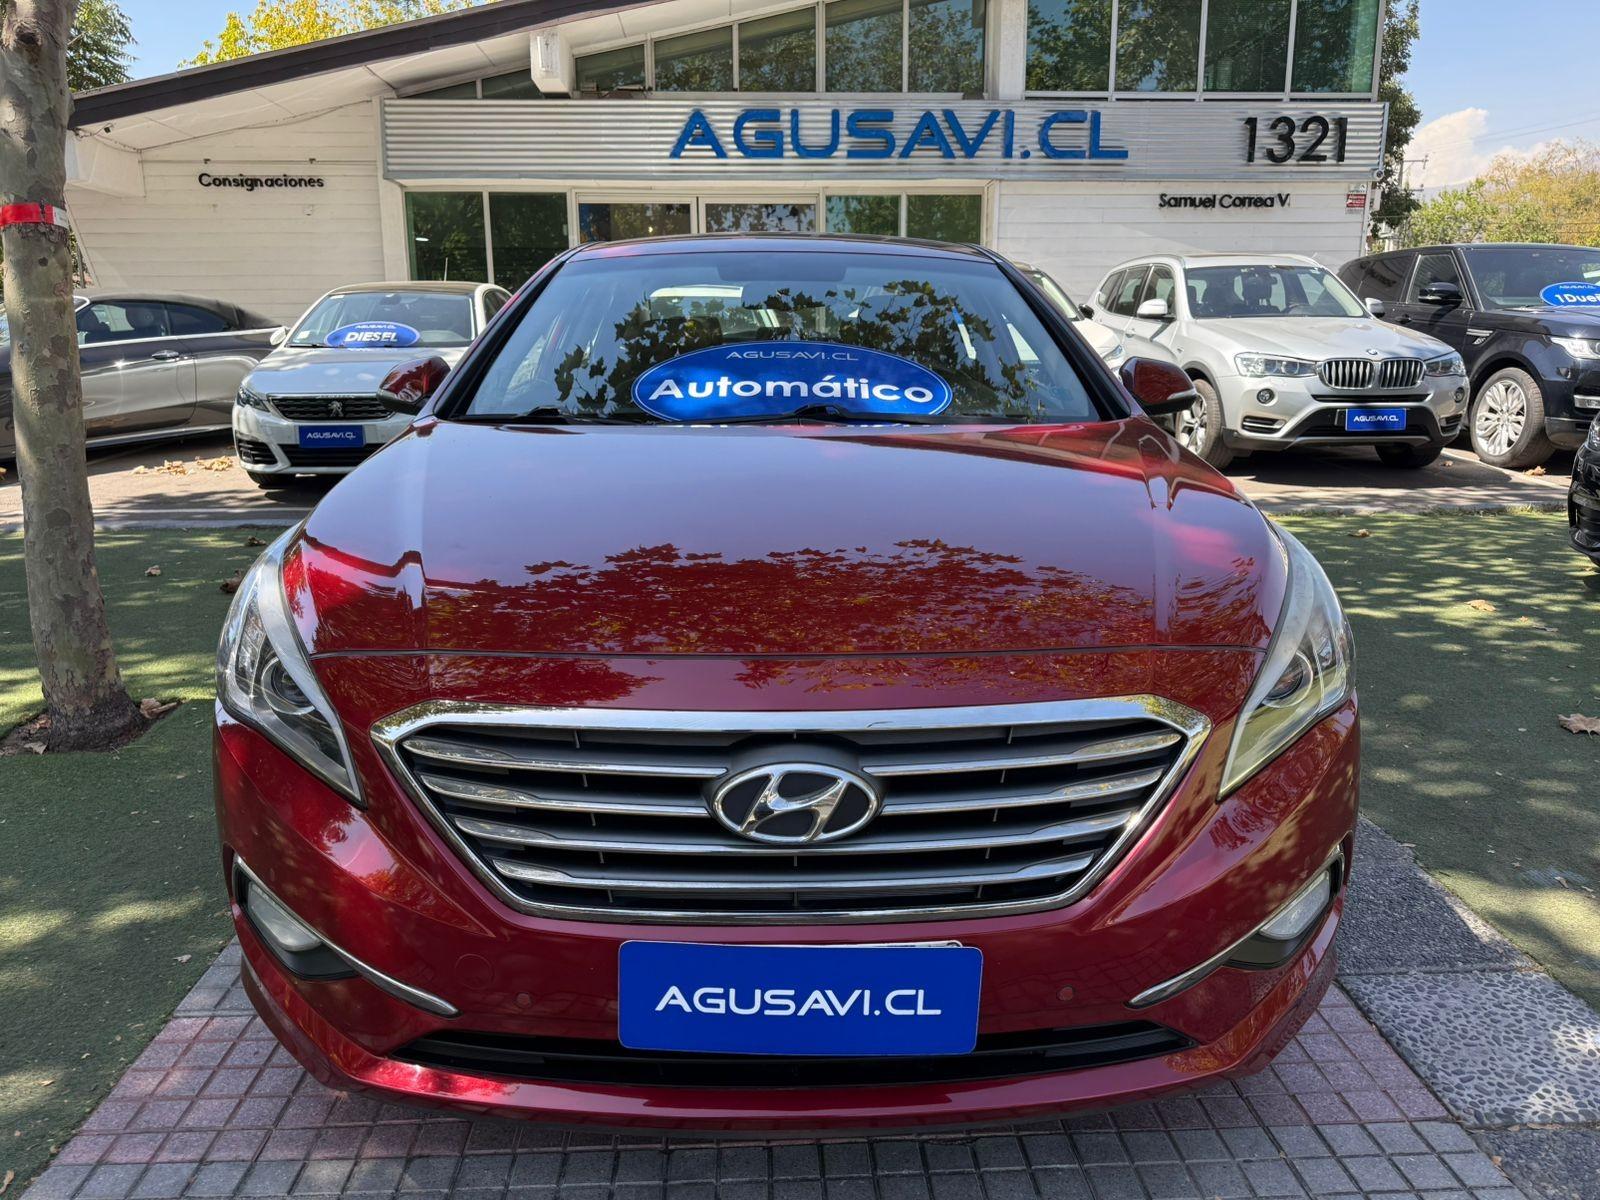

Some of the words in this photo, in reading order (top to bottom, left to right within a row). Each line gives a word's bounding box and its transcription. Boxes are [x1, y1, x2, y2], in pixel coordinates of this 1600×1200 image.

[670, 108, 1128, 159] AGUSAVI.CL
[1243, 115, 1348, 163] 1321
[198, 173, 325, 192] Consignaciones
[1159, 193, 1216, 209] Samuel
[1219, 195, 1275, 209] Correa
[344, 331, 398, 342] DIESEL
[726, 350, 859, 361] AGUSAVI.CL
[649, 374, 934, 403] Automático
[306, 432, 357, 440] AGUSAVI.CL
[655, 985, 942, 1017] AGUSAVI.CL
